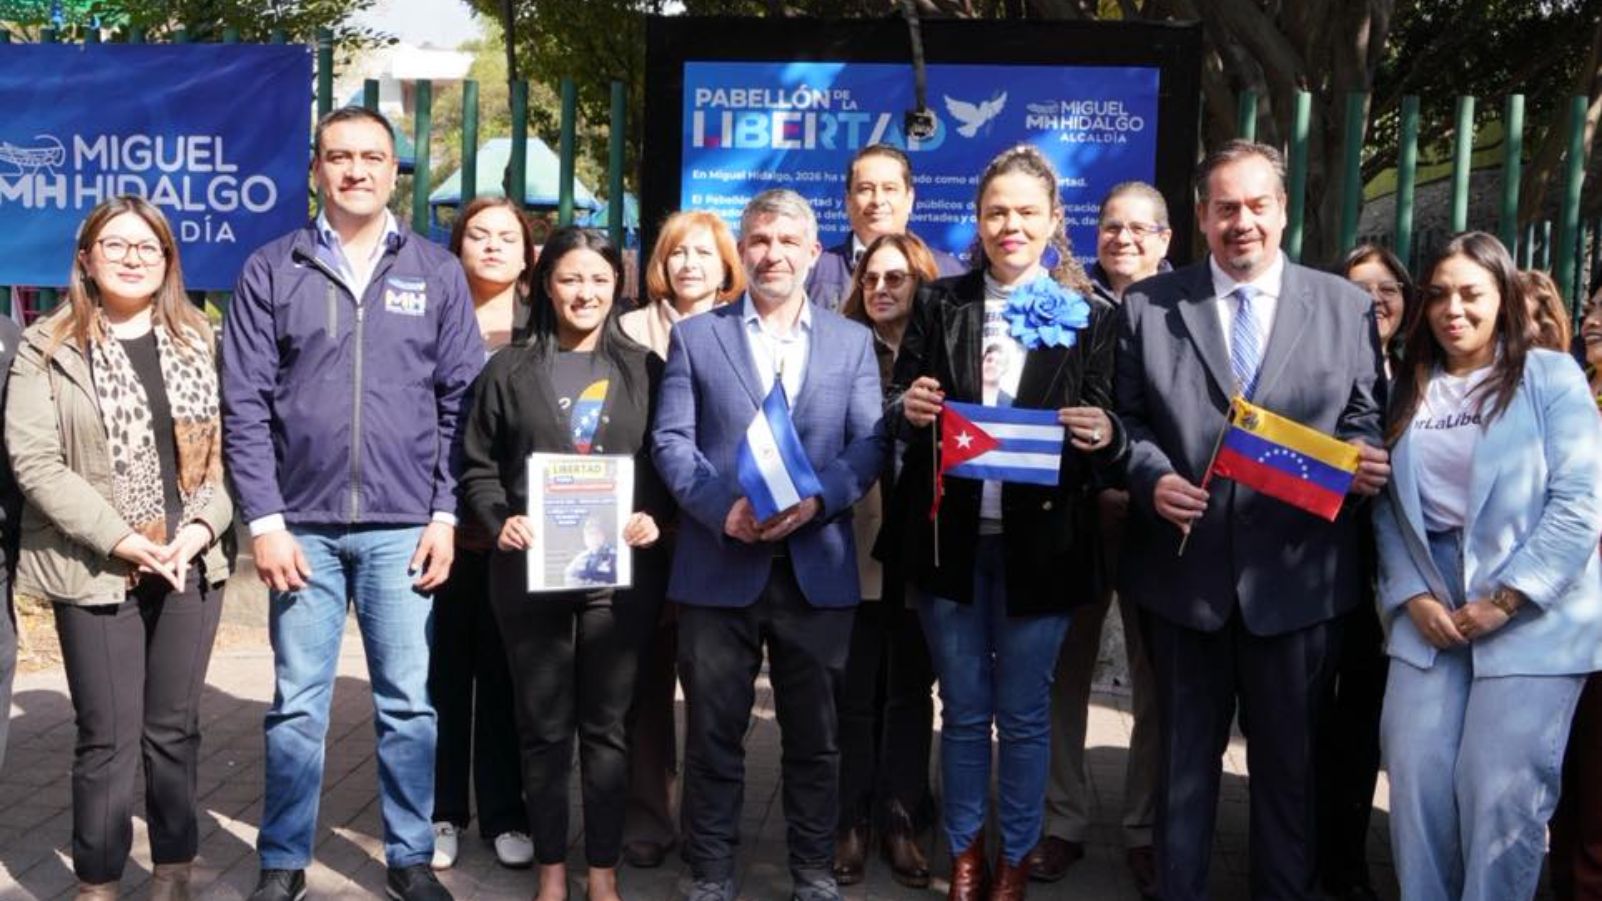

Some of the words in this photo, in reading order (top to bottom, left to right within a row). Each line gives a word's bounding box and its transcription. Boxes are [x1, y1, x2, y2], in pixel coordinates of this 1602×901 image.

[695, 84, 830, 109] PABELLÓN
[833, 90, 850, 100] DE
[842, 100, 857, 110] LA
[1061, 101, 1128, 116] MIGUEL
[1025, 115, 1058, 129] MH
[1061, 115, 1144, 132] HIDALGO
[1060, 132, 1127, 144] ALCALDÍA
[73, 134, 238, 172] MIGUEL
[692, 169, 706, 180] En
[709, 170, 746, 182] Miguel
[935, 176, 967, 184] como
[0, 174, 67, 209] MH
[75, 174, 277, 213] HIDALGO
